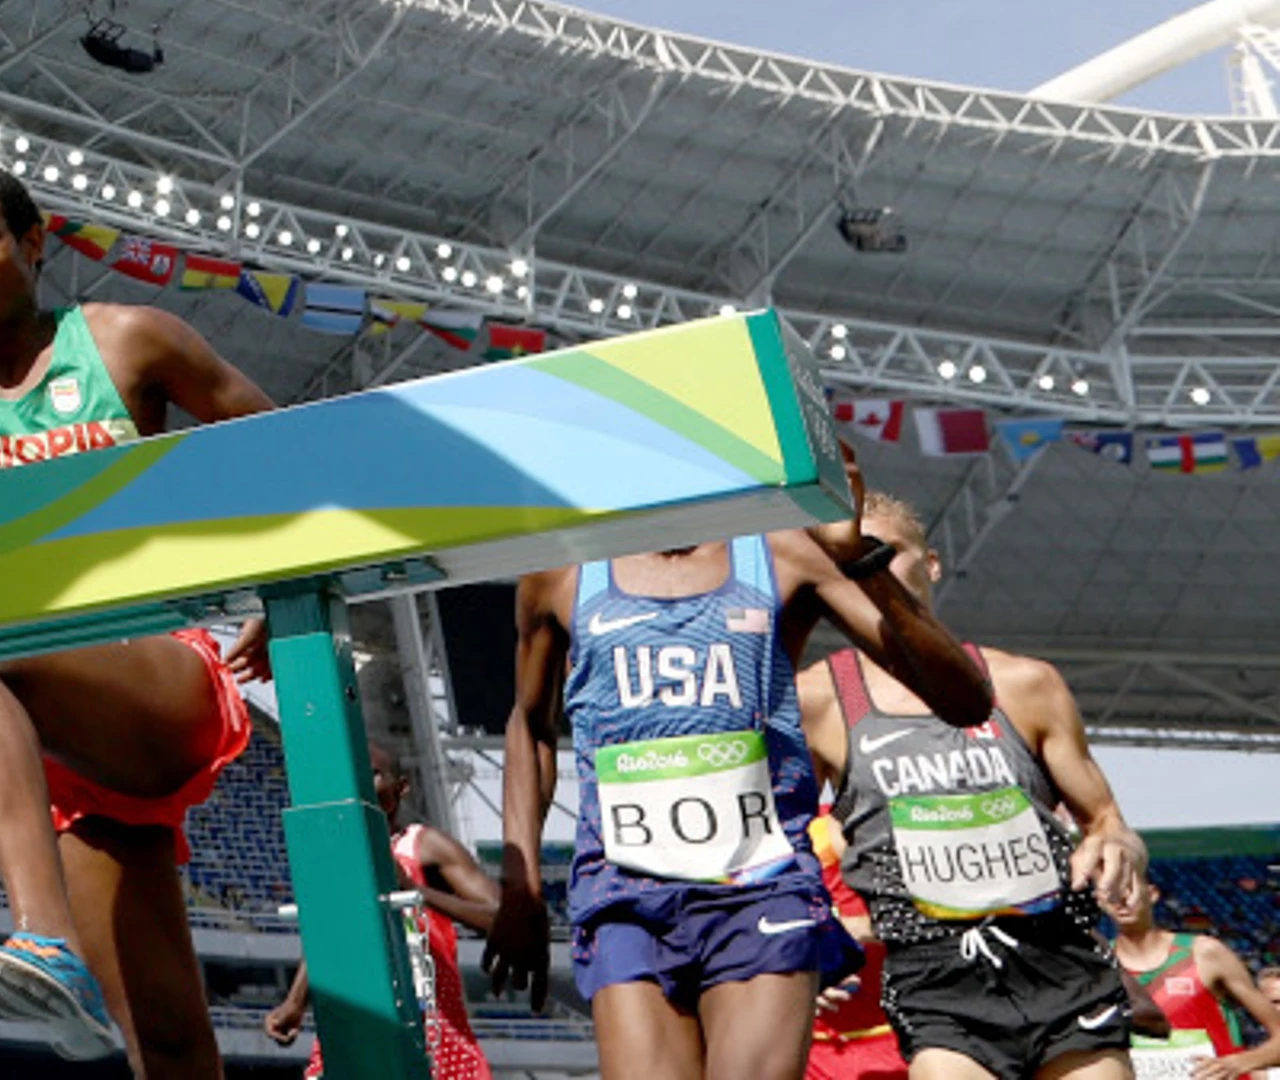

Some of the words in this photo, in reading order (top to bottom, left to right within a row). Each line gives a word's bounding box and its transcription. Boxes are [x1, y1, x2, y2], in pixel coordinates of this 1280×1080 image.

[613, 643, 743, 709] USA
[616, 749, 690, 773] Rio2016
[872, 746, 1017, 797] CANADA
[611, 791, 773, 847] BOR
[902, 832, 1051, 883] HUGHES
